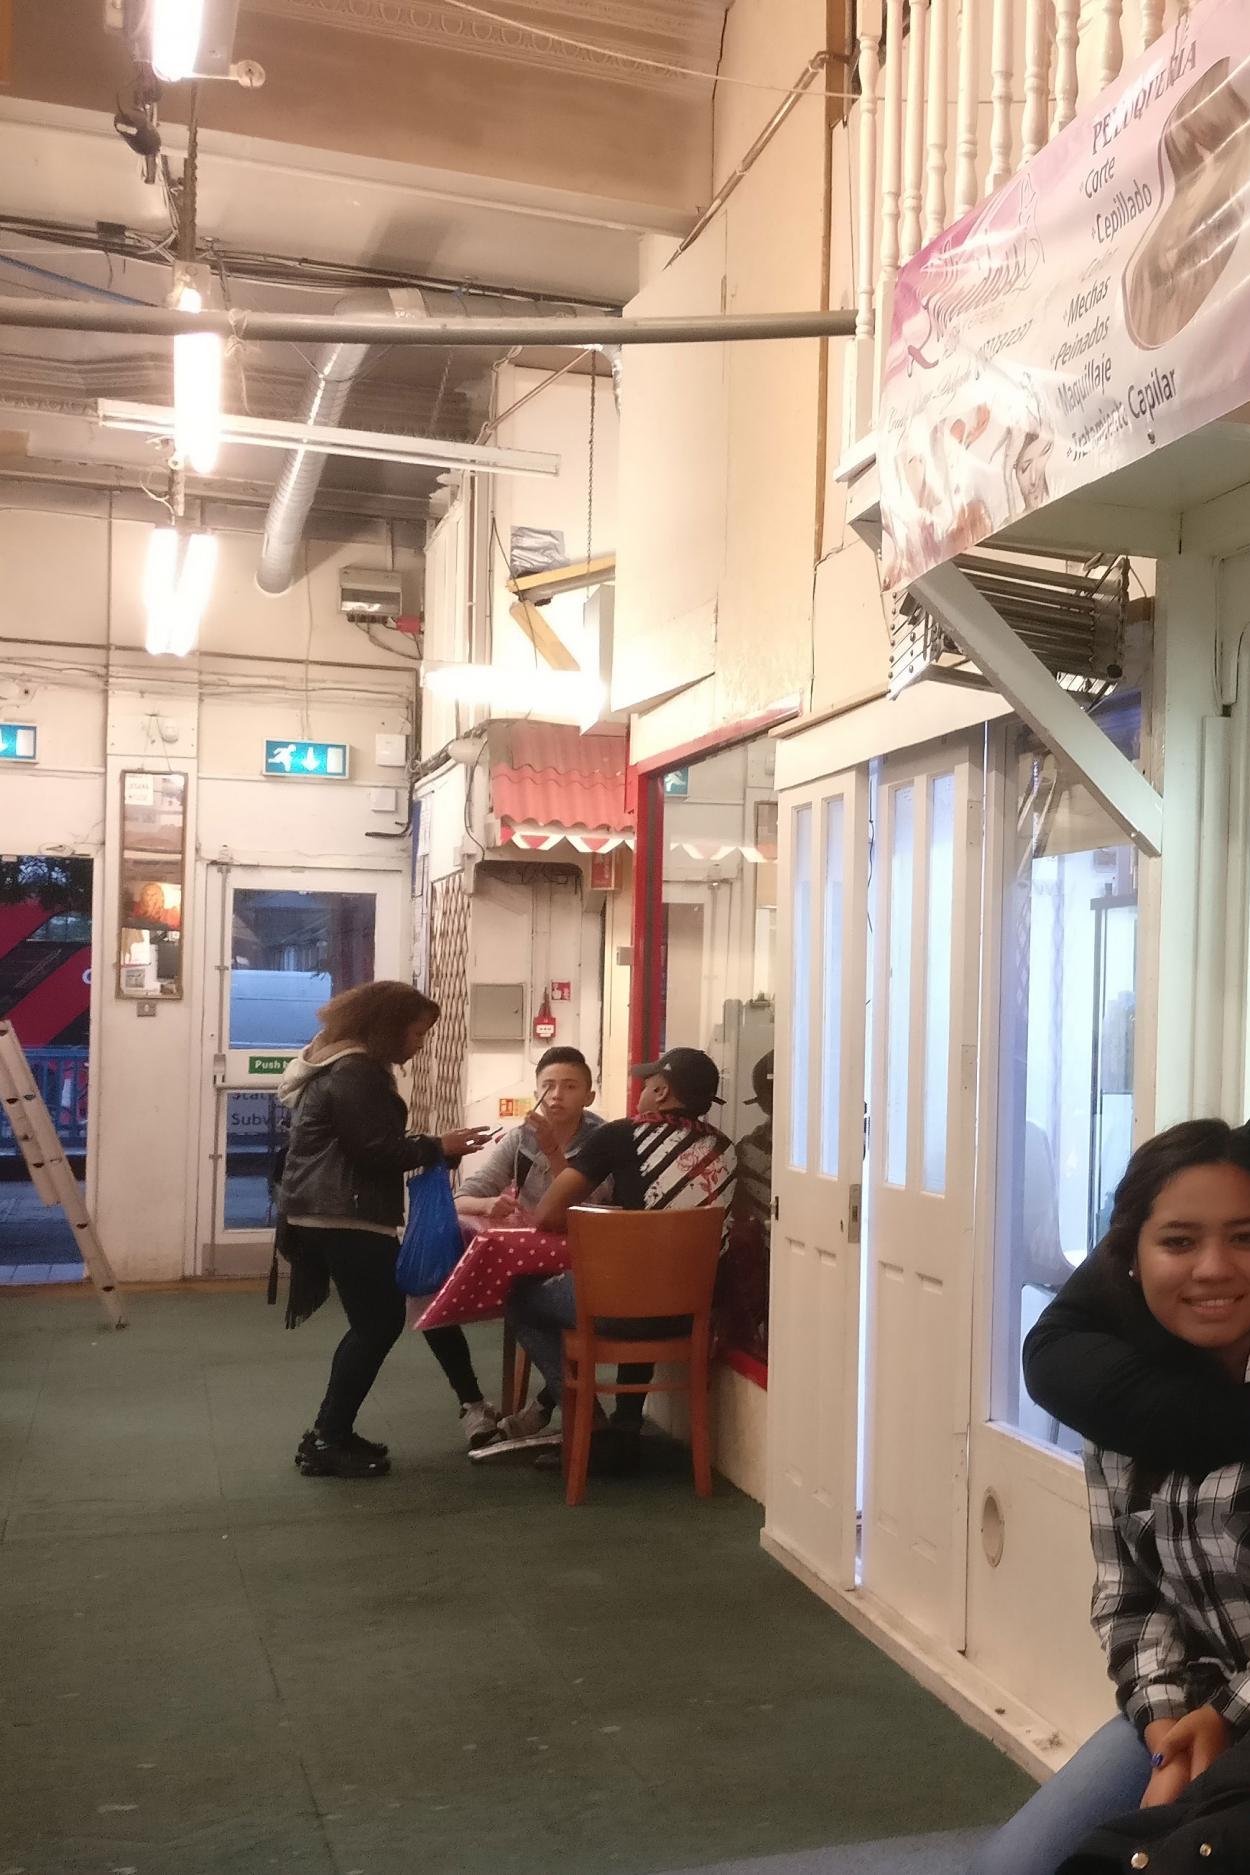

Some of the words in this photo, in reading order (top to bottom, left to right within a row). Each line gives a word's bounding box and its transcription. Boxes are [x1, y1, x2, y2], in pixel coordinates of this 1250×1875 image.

[1085, 156, 1115, 199] Corte
[1095, 179, 1152, 243] Cepillado
[1067, 275, 1112, 327] Mechas
[1054, 315, 1111, 371] Peinados
[1058, 353, 1112, 417] Maquillaje
[1127, 368, 1177, 421] Capilar
[255, 1060, 280, 1069] Push
